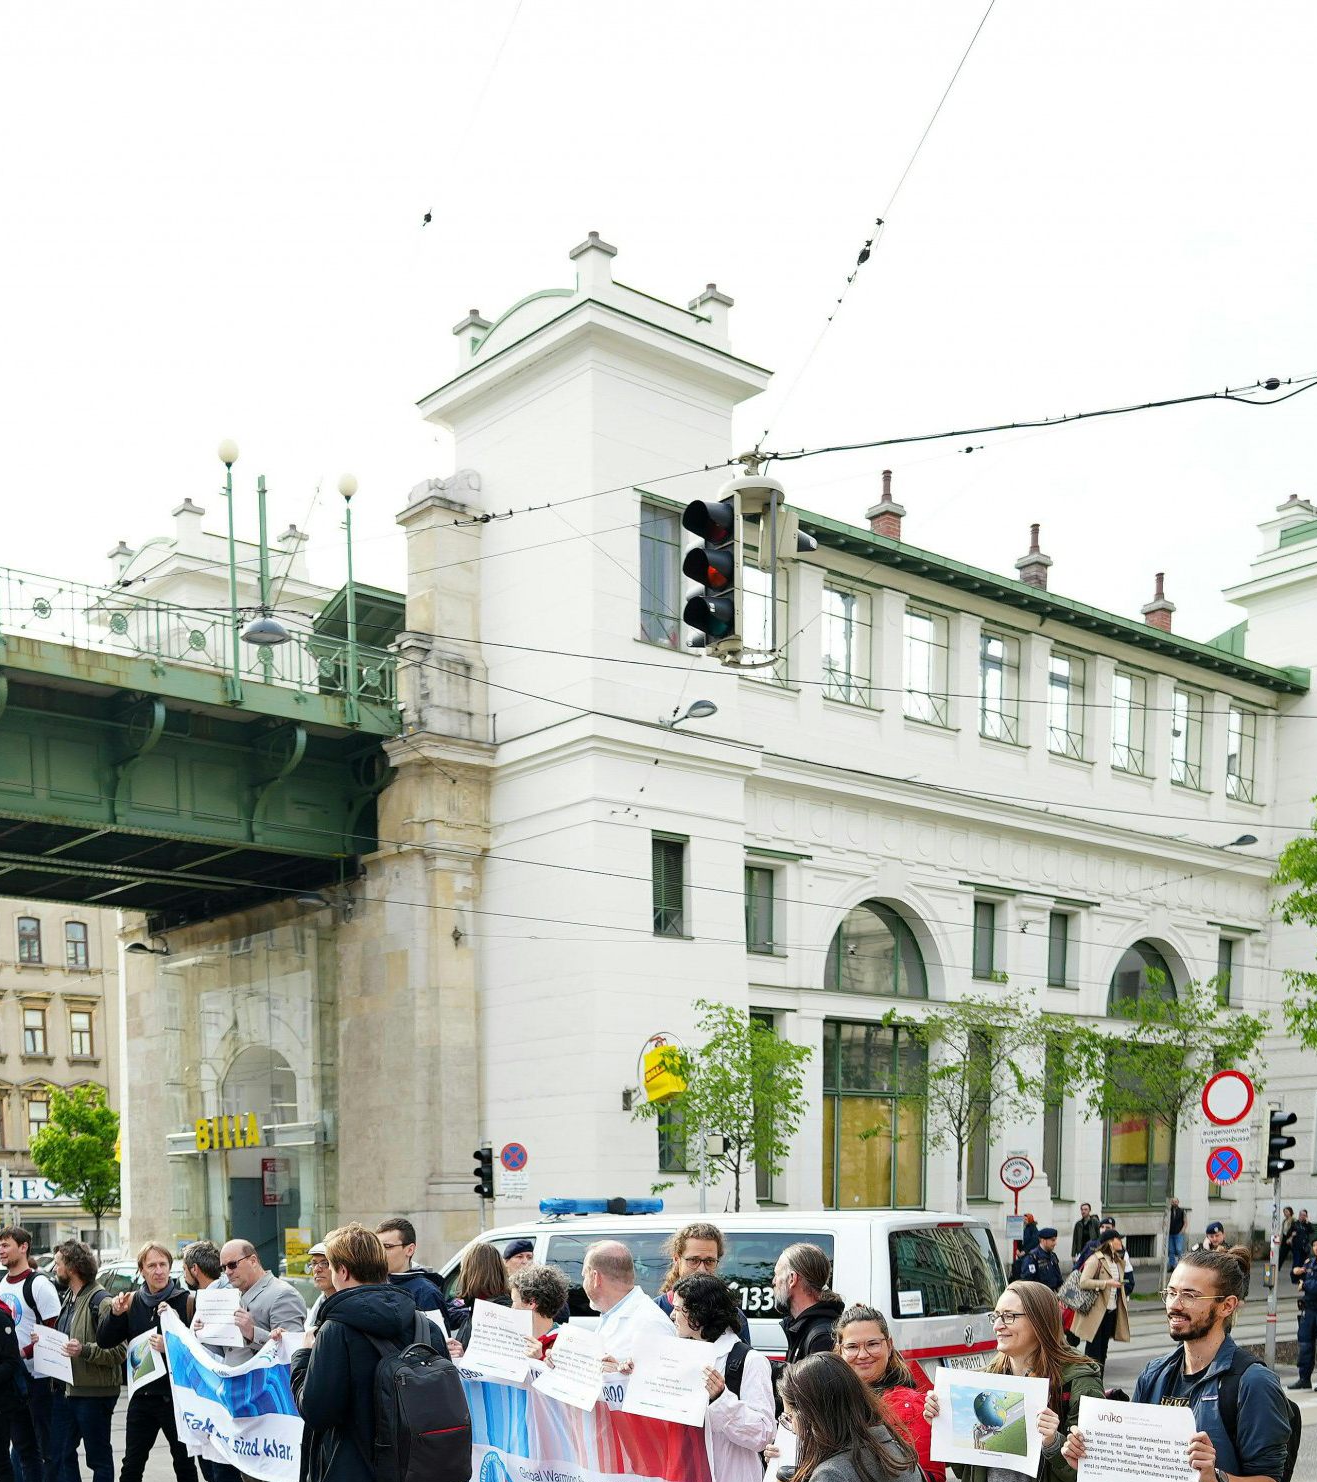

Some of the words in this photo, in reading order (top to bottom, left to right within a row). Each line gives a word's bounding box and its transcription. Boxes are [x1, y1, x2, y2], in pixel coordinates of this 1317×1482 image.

[195, 1112, 260, 1151] BILLA
[739, 1287, 774, 1311] 133
[1097, 1411, 1123, 1423] uniko
[232, 1436, 260, 1456] sind
[263, 1438, 293, 1461] klar.
[519, 1467, 544, 1482] Global
